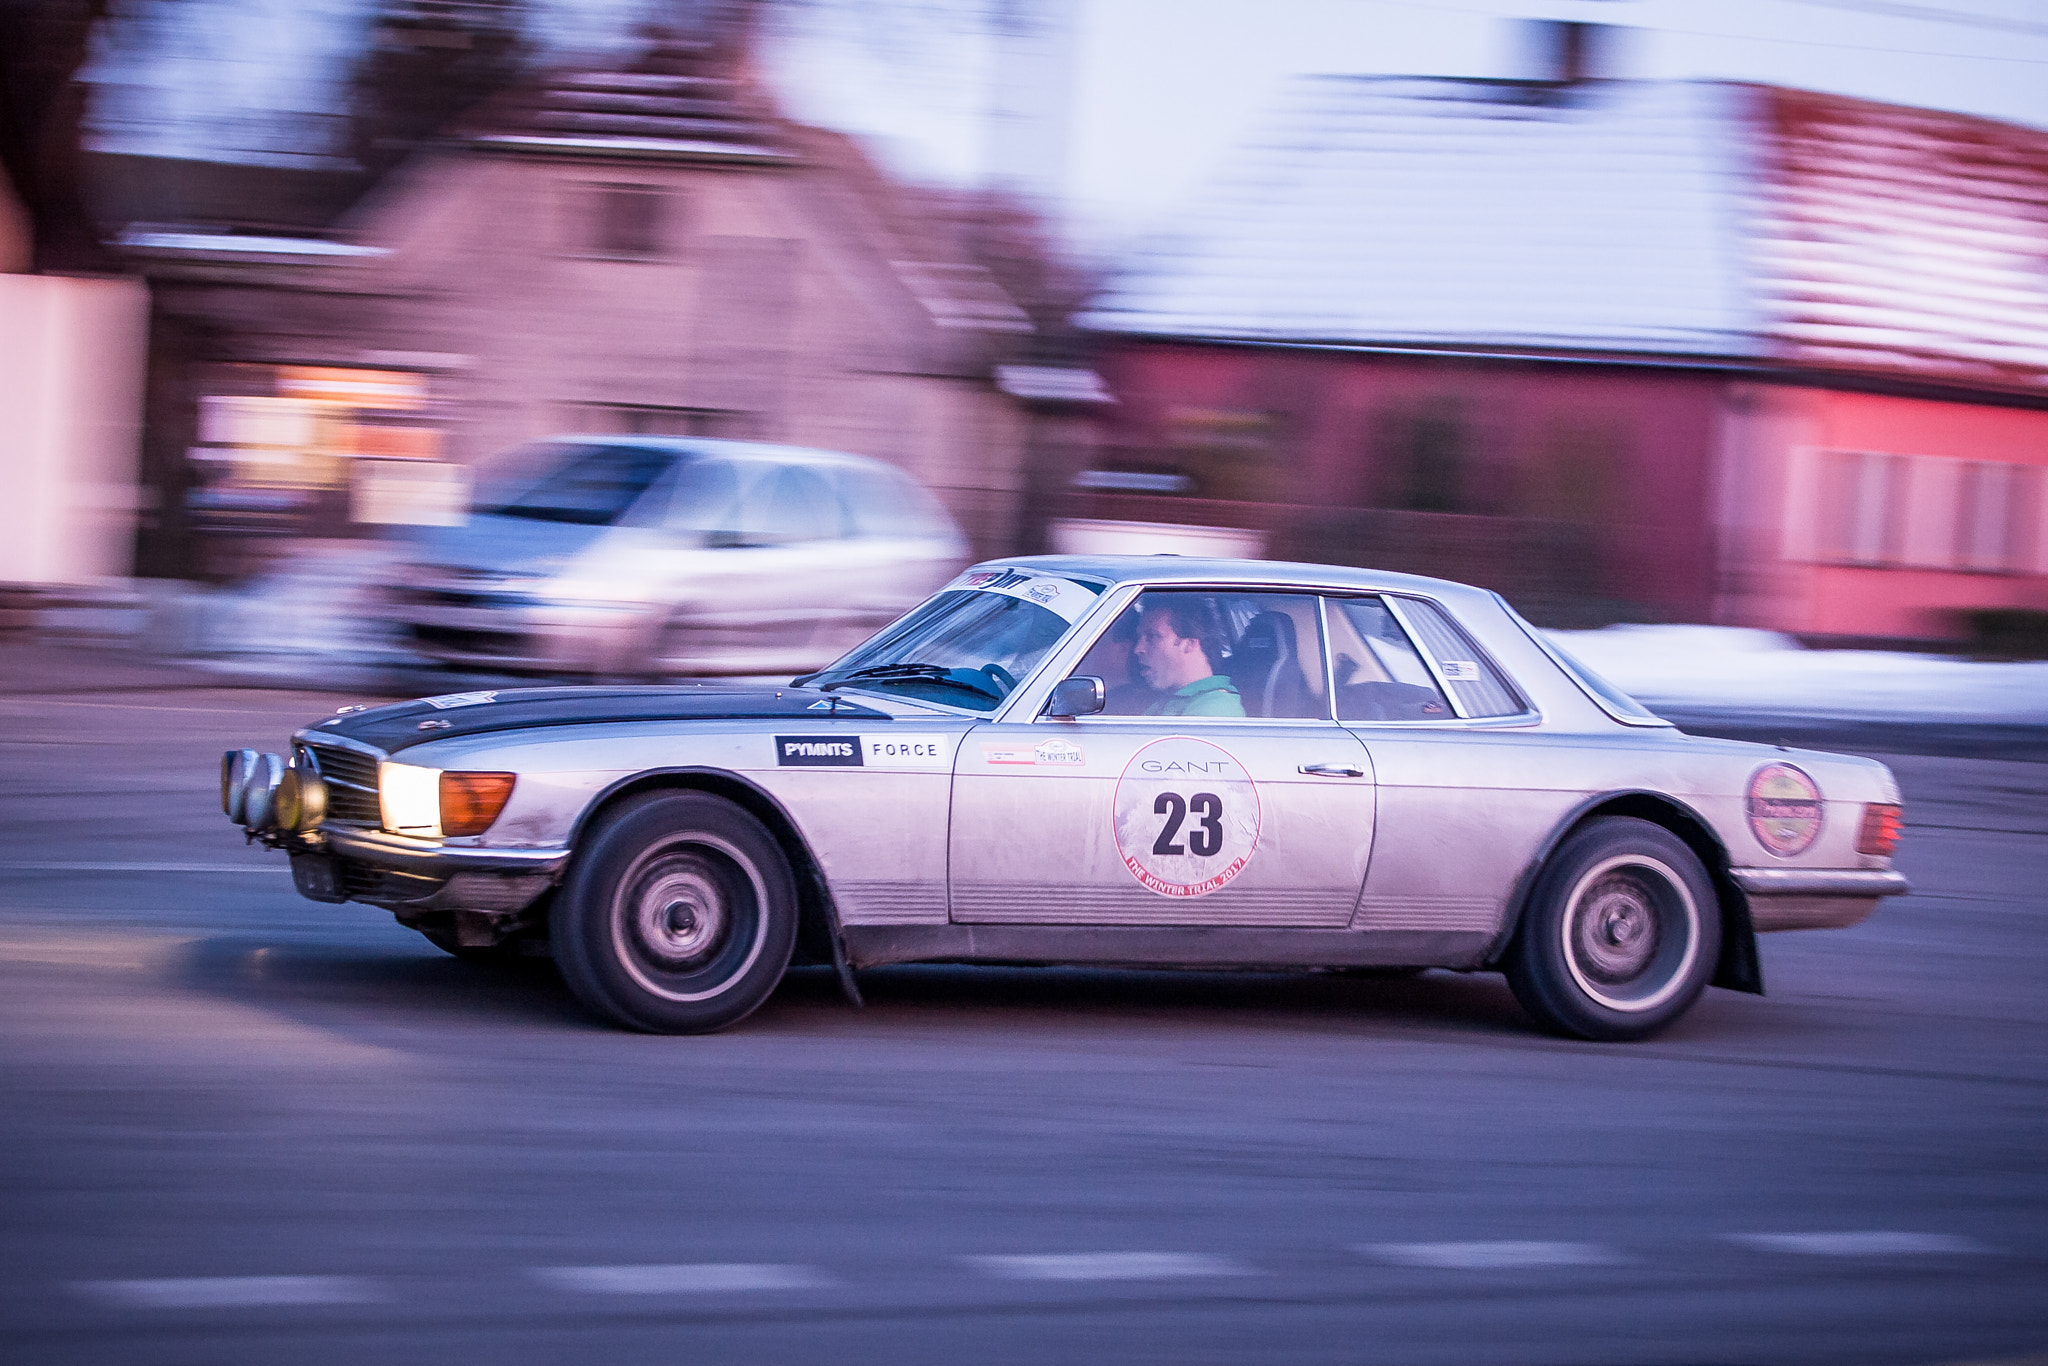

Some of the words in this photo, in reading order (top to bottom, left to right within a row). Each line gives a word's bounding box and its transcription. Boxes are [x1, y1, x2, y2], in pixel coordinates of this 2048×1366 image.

[784, 742, 854, 757] PYMNTS
[872, 743, 937, 756] FORCE
[1141, 760, 1229, 773] GANT
[1152, 792, 1223, 857] 23
[1128, 858, 1146, 878] THE
[1145, 874, 1185, 895] WINTER
[1188, 879, 1220, 895] TRIAL
[1221, 858, 1242, 883] 2017
